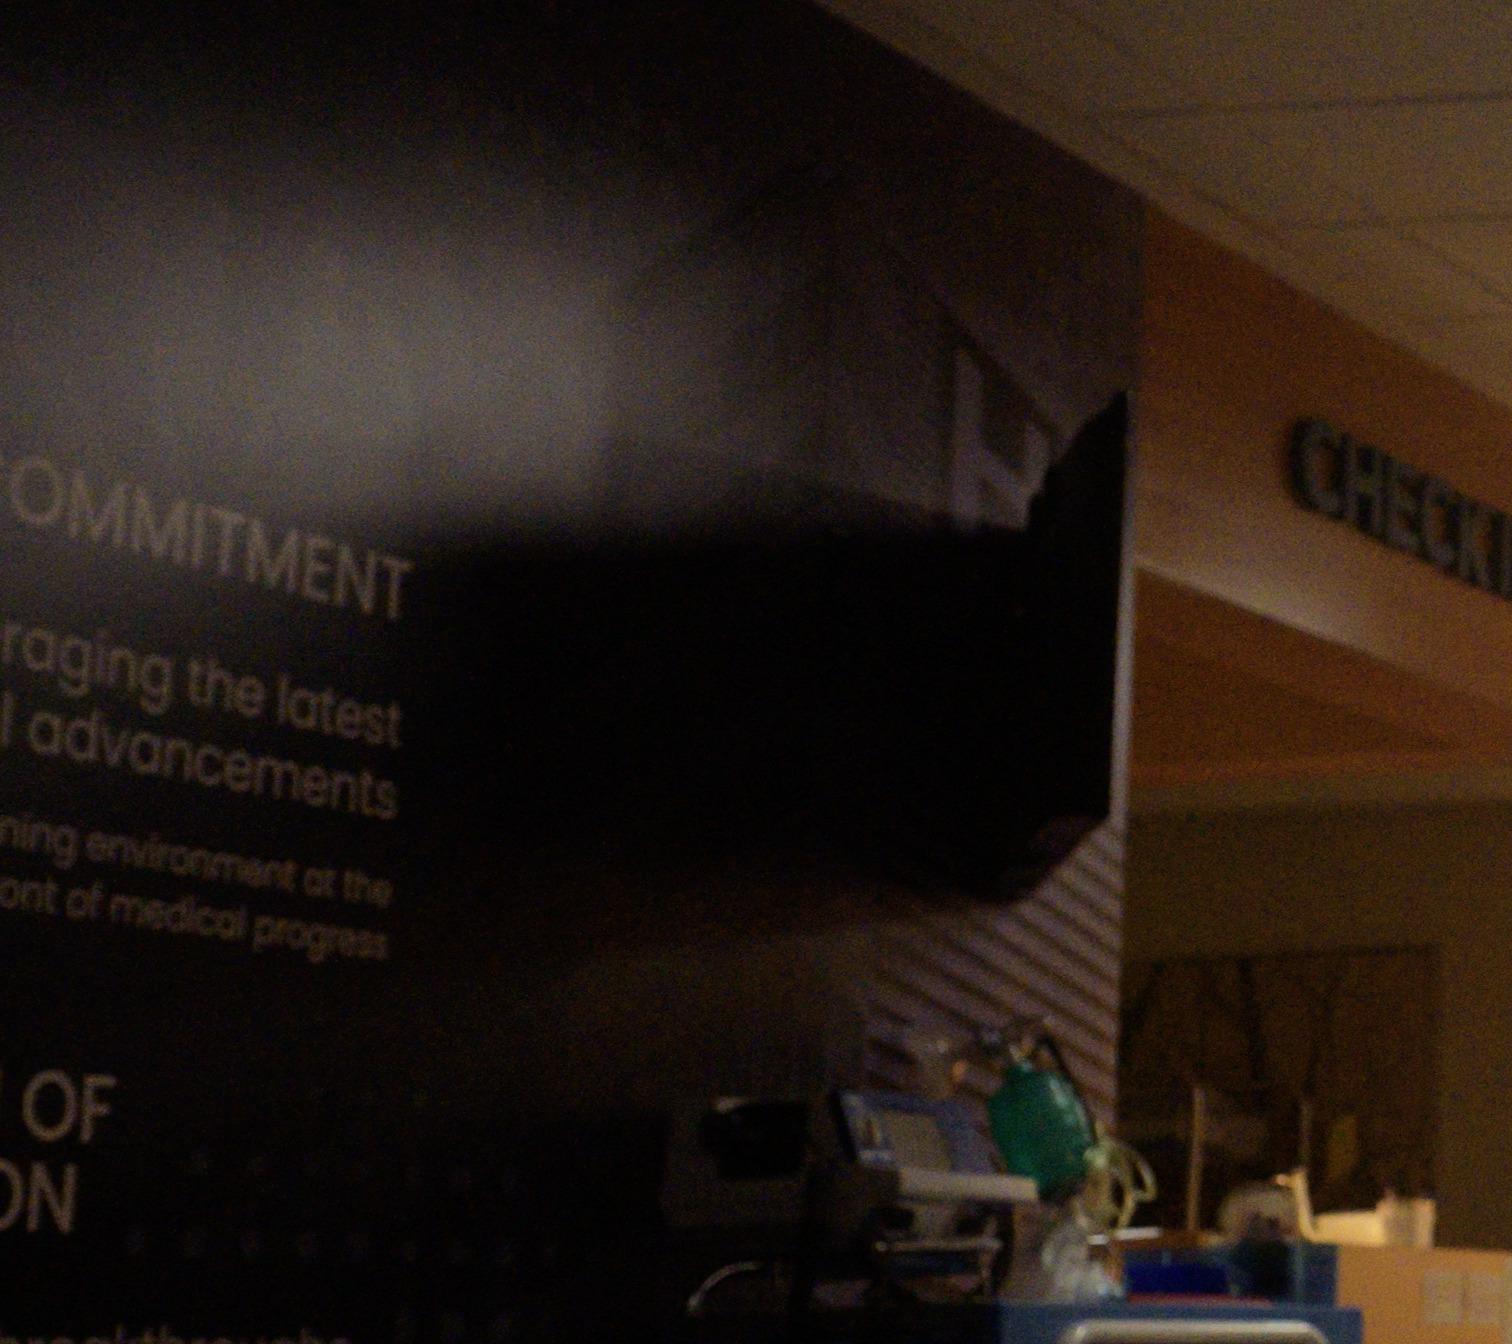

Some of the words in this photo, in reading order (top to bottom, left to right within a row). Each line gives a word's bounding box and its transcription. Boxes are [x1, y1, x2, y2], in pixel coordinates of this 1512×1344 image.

[10, 458, 412, 621] OMMITMENT
[2, 620, 172, 715] raging
[188, 657, 266, 718] the
[277, 670, 402, 749] latest
[29, 709, 401, 821] advancements
[85, 830, 298, 893] environment
[303, 864, 336, 898] at
[342, 869, 394, 908] the
[65, 882, 105, 920] of
[109, 892, 248, 940] medical
[251, 912, 390, 964] progress
[21, 1068, 118, 1145] OF
